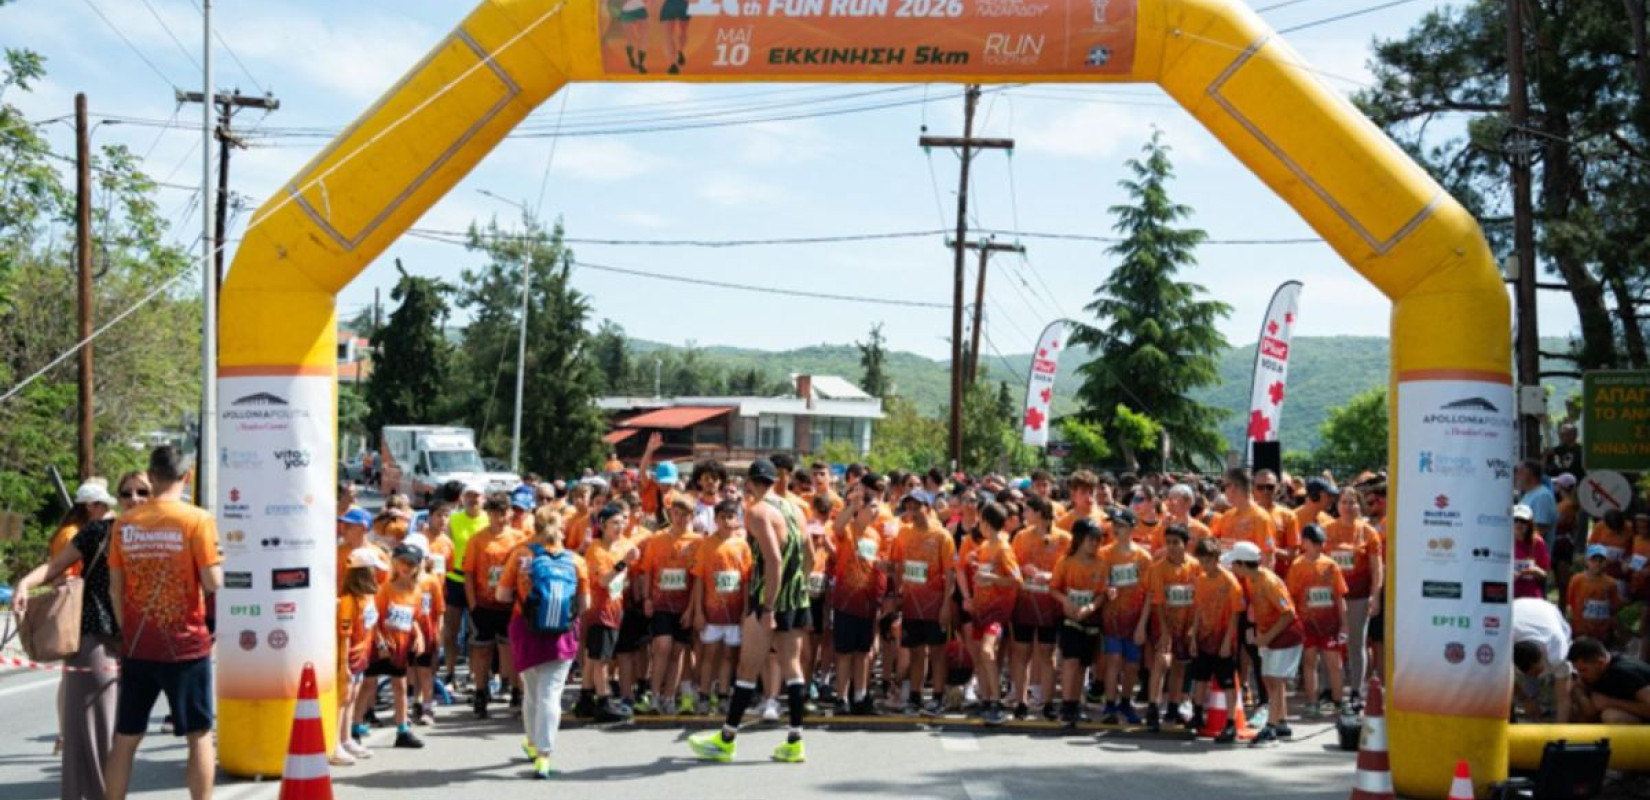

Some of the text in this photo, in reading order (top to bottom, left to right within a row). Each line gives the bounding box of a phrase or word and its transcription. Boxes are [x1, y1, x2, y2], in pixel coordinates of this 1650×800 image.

[767, 0, 822, 17] FUN
[829, 0, 889, 17] RUN
[895, 0, 964, 18] 2026
[983, 33, 1045, 55] RUN
[712, 43, 750, 66] 10
[768, 46, 970, 65] ΕΚΚΙΝΗΣΗ 5km
